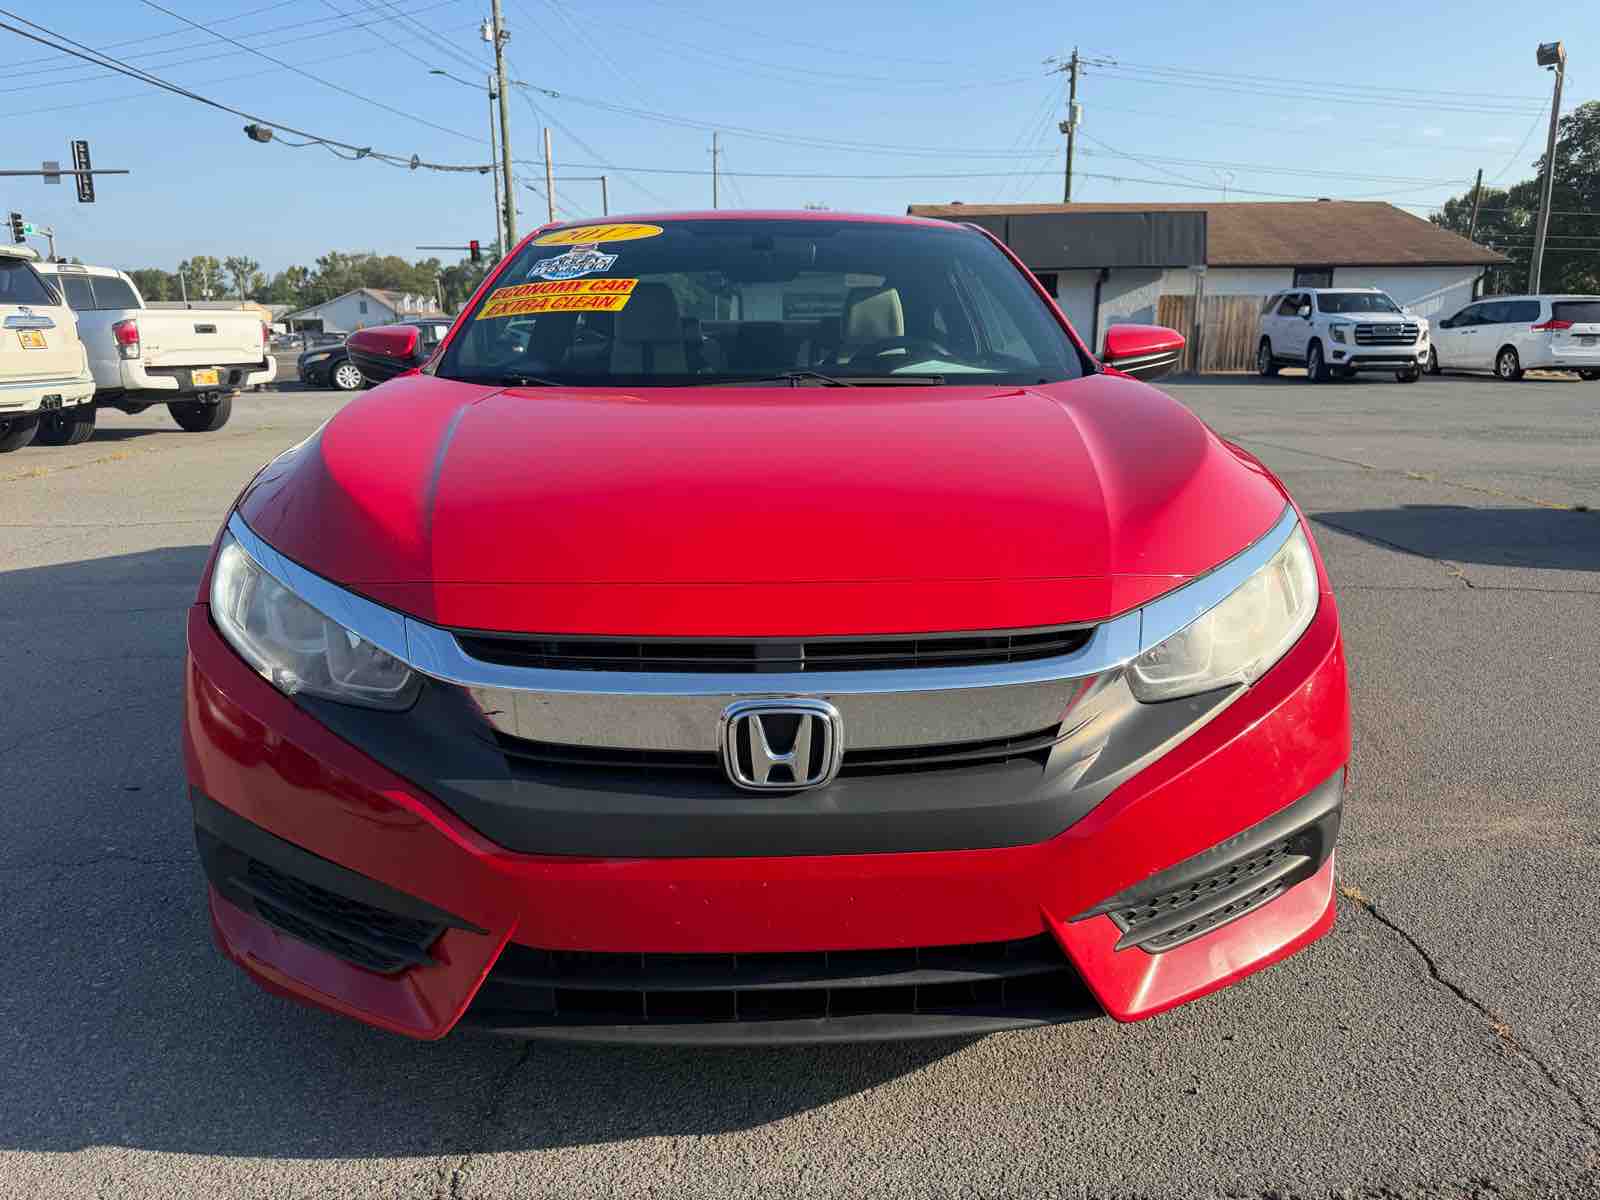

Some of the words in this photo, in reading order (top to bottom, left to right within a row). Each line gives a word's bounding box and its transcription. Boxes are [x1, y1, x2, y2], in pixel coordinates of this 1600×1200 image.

[492, 280, 583, 300] ECONOMY
[589, 279, 634, 292] CAR
[485, 297, 549, 316] EXTRA
[550, 295, 618, 309] CLEAN
